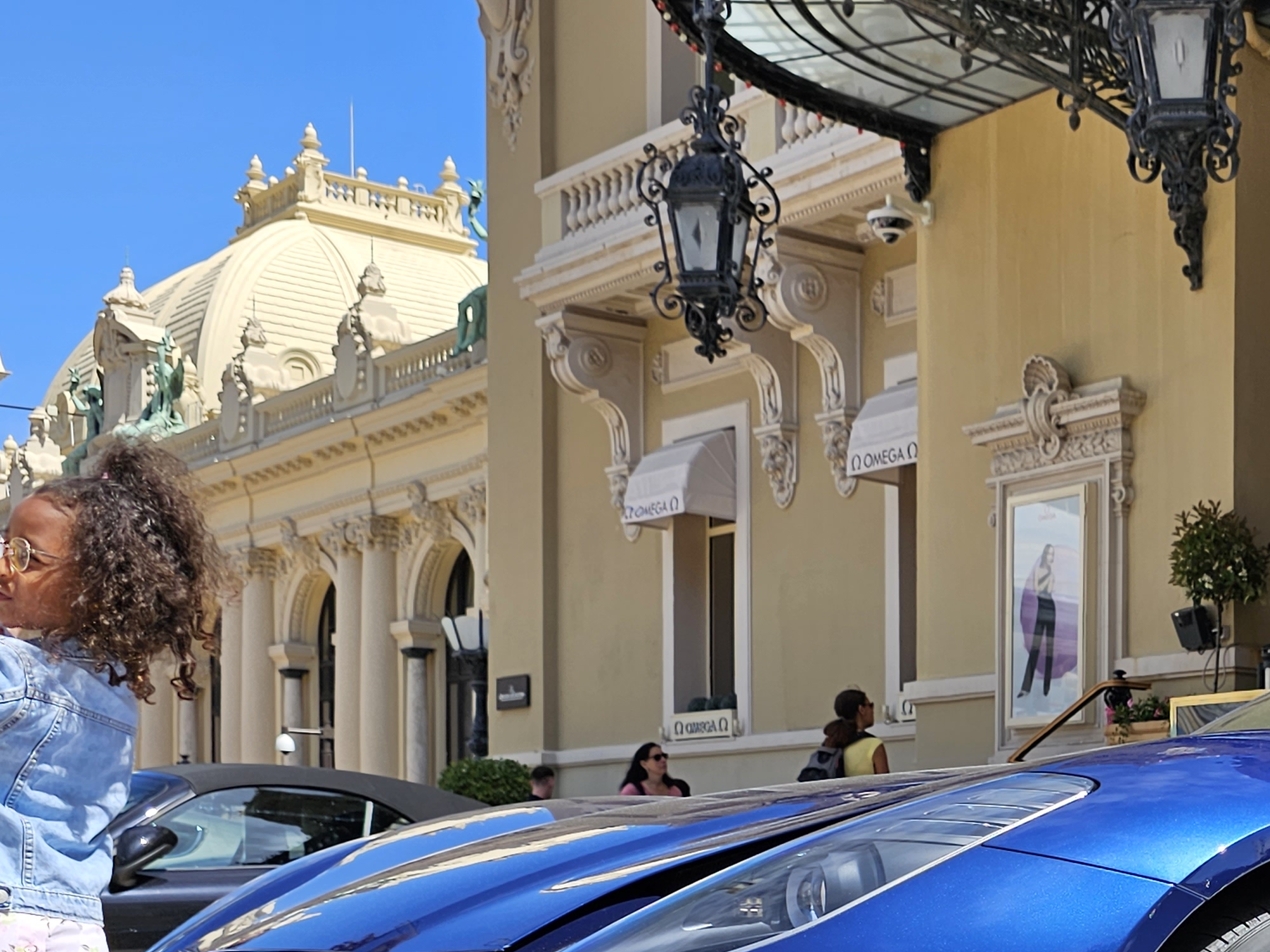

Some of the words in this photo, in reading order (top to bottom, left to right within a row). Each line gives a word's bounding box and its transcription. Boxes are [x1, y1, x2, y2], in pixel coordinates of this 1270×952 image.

[863, 447, 905, 469] OMEGA
[634, 501, 668, 518] OMEGA
[685, 719, 717, 734] OMEGA
